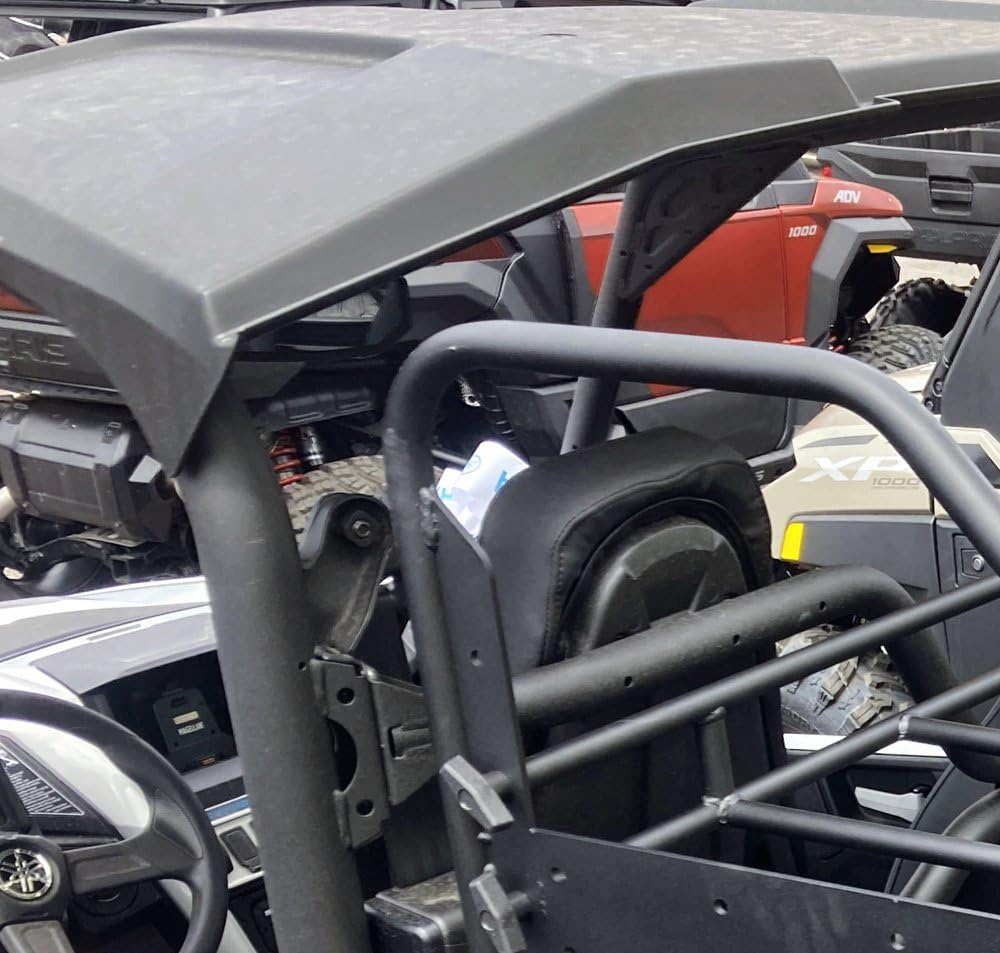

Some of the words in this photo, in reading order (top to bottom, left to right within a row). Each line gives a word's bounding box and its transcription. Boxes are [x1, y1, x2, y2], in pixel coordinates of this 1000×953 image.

[833, 189, 861, 204] ADV
[788, 224, 817, 238] 1000
[800, 455, 909, 482] XP
